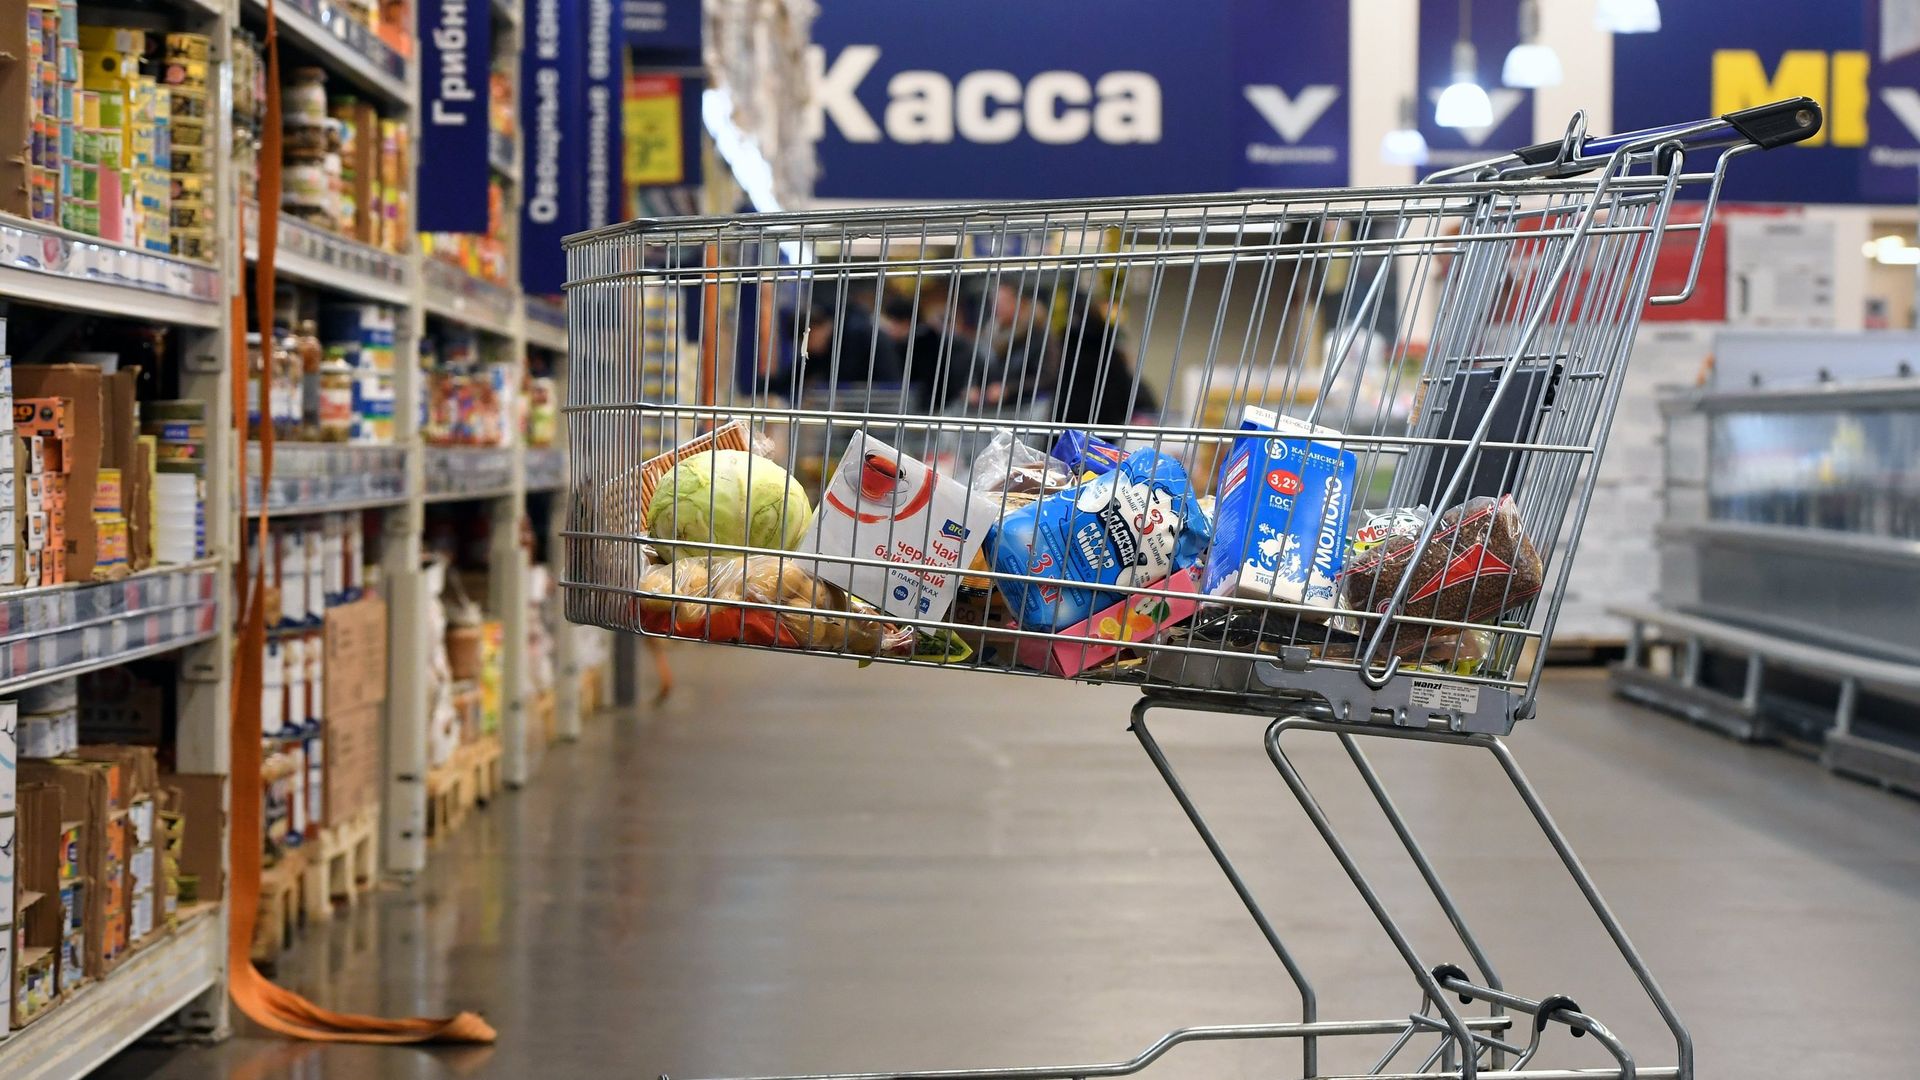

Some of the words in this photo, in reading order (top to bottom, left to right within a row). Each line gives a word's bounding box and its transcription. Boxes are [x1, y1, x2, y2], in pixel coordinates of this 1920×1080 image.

[432, 0, 475, 125] Грибн
[806, 44, 1164, 145] Касса
[529, 68, 562, 223] Овощные
[1269, 495, 1293, 507] ГОСТ
[1270, 473, 1301, 493] 3,2%
[932, 540, 959, 563] Чай
[1133, 508, 1164, 535] 3
[1314, 476, 1343, 570] МОЛОКО
